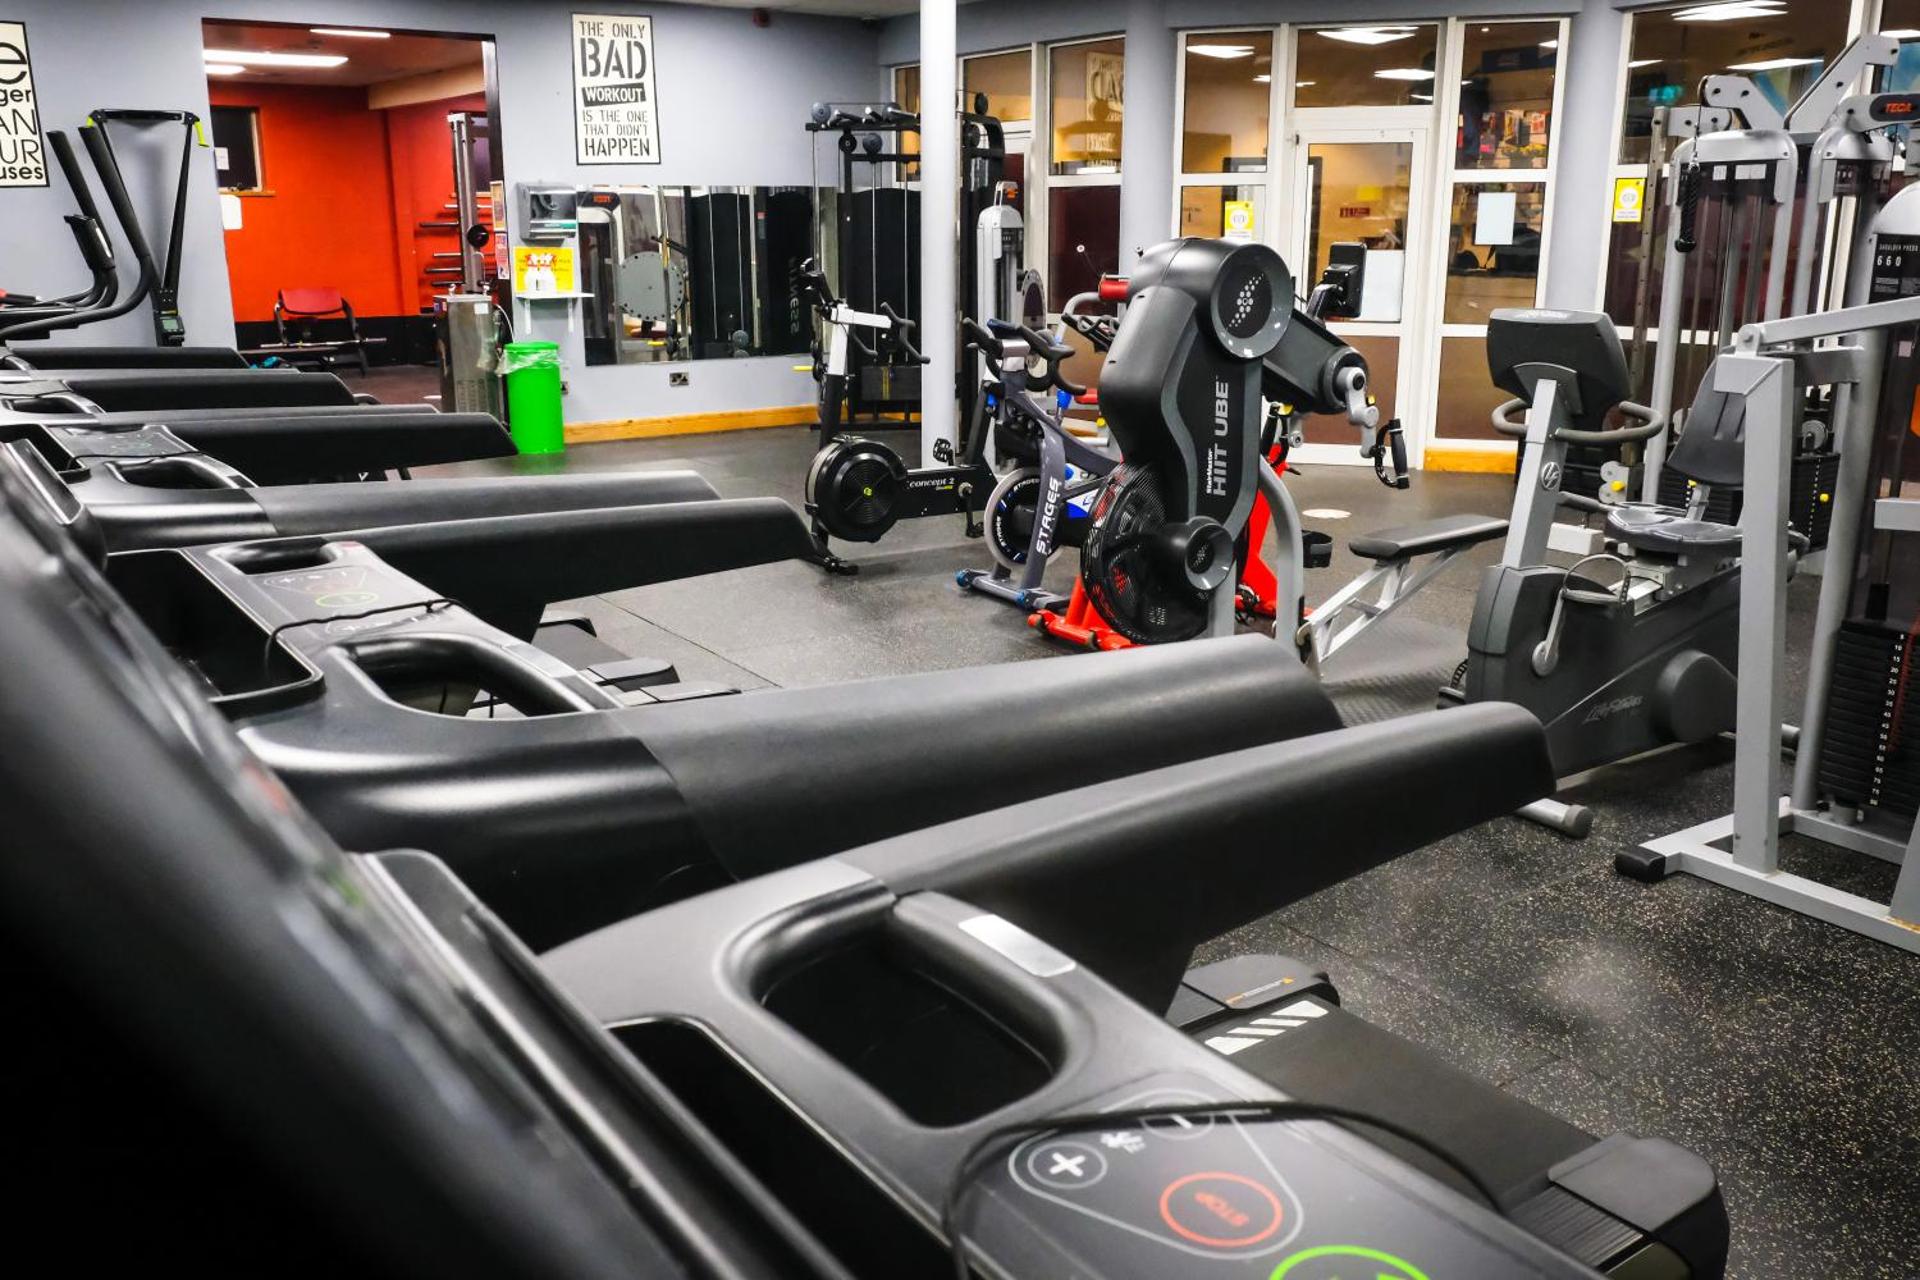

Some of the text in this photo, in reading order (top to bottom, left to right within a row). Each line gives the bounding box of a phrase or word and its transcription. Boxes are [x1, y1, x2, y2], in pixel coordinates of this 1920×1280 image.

[579, 21, 645, 39] THE ONLY
[580, 37, 647, 79] BAD
[584, 86, 643, 102] WORKOUT
[582, 109, 648, 123] IS THE ONE
[583, 124, 648, 136] THAT DIDN'T
[584, 138, 650, 156] HAPPEN
[1877, 255, 1902, 267] 660
[1213, 381, 1229, 496] HIIT UBE
[909, 478, 947, 488] concept
[1036, 477, 1061, 555] STAGES
